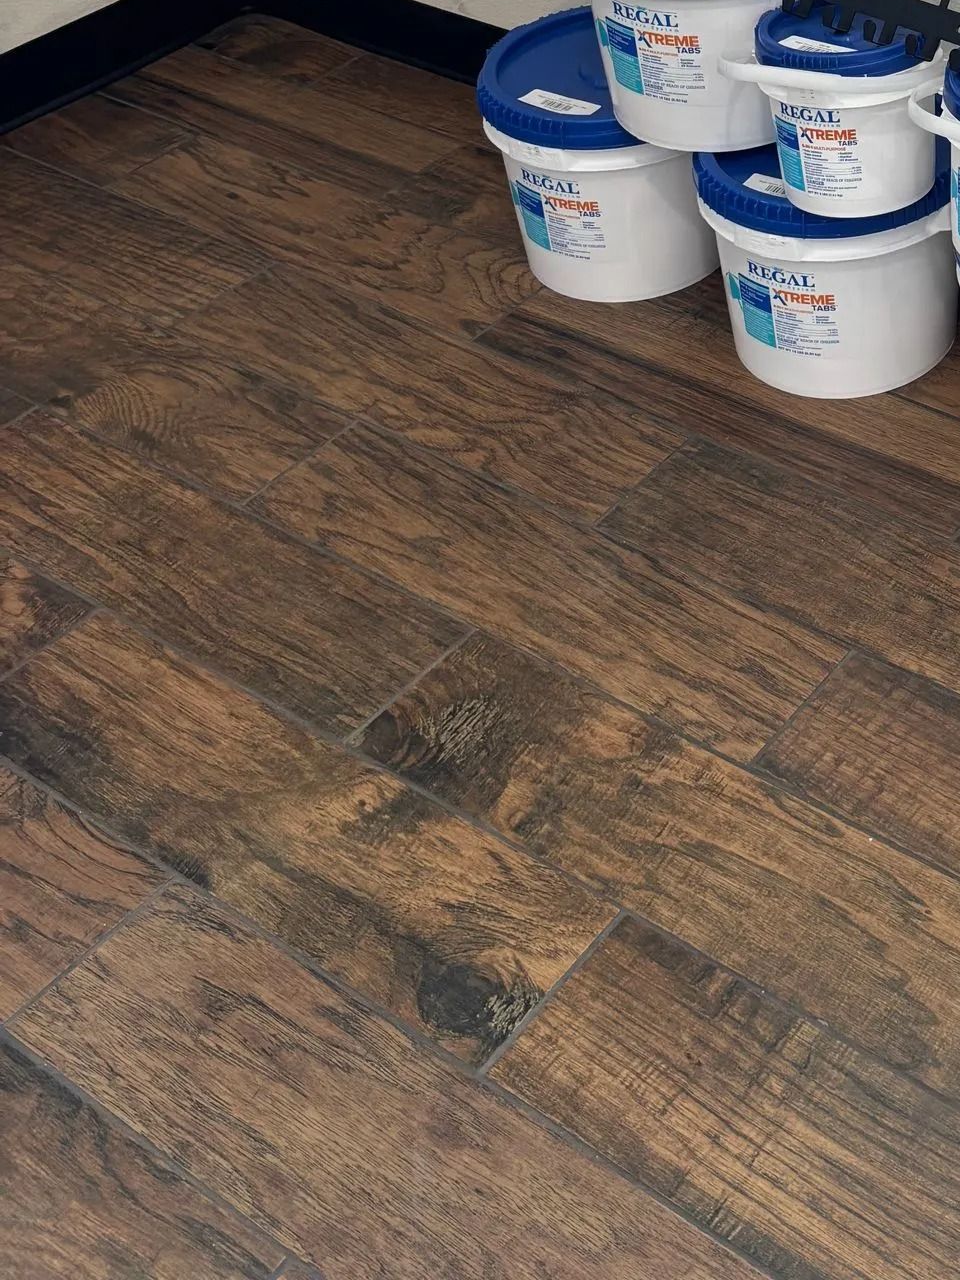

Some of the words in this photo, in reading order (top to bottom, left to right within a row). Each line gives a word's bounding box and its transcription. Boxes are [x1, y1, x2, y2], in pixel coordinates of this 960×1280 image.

[613, 1, 678, 27] REGAL
[637, 30, 699, 48] XTREME
[780, 102, 840, 123] REGAL
[800, 127, 856, 143] XTREME
[521, 169, 579, 194] REGAL
[544, 195, 599, 211] XTREME
[747, 262, 815, 288] REGAL
[773, 288, 835, 306] XTREME
